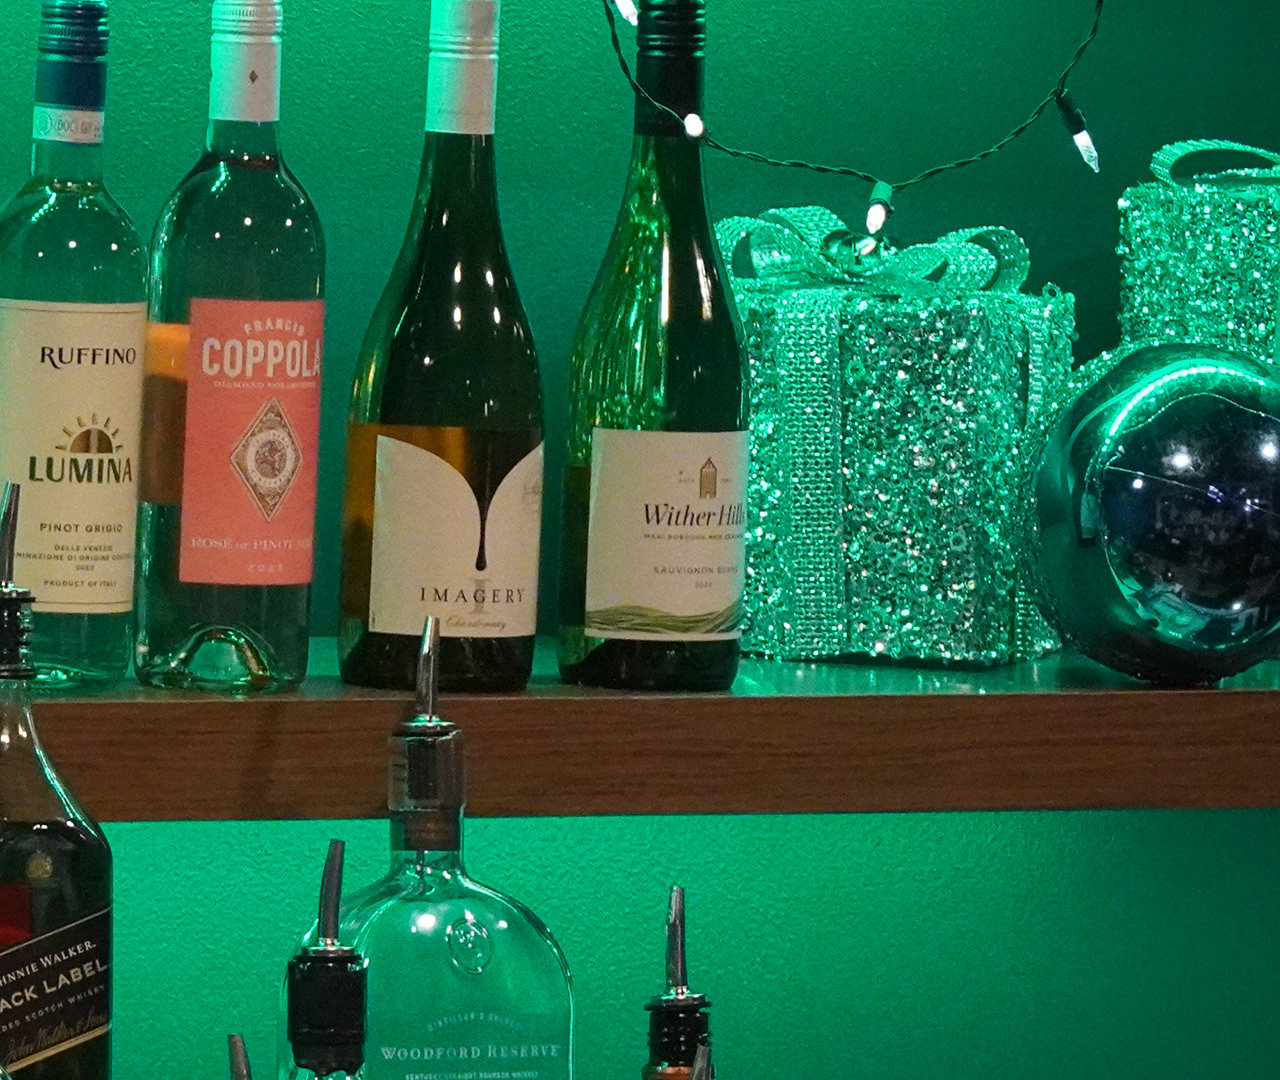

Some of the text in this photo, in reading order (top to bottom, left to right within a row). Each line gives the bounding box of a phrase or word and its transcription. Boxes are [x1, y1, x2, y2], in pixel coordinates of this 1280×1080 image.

[243, 318, 305, 338] FRANCIS
[40, 346, 137, 369] RUFFINO
[29, 456, 133, 484] LUMINA
[644, 503, 717, 527] Wither
[39, 523, 123, 533] PINOT GRIGIO
[420, 587, 526, 603] IMAGERY
[40, 941, 94, 969] WALKER
[43, 958, 109, 995] LABEL
[380, 1044, 559, 1061] WOODFORD RESERVE
